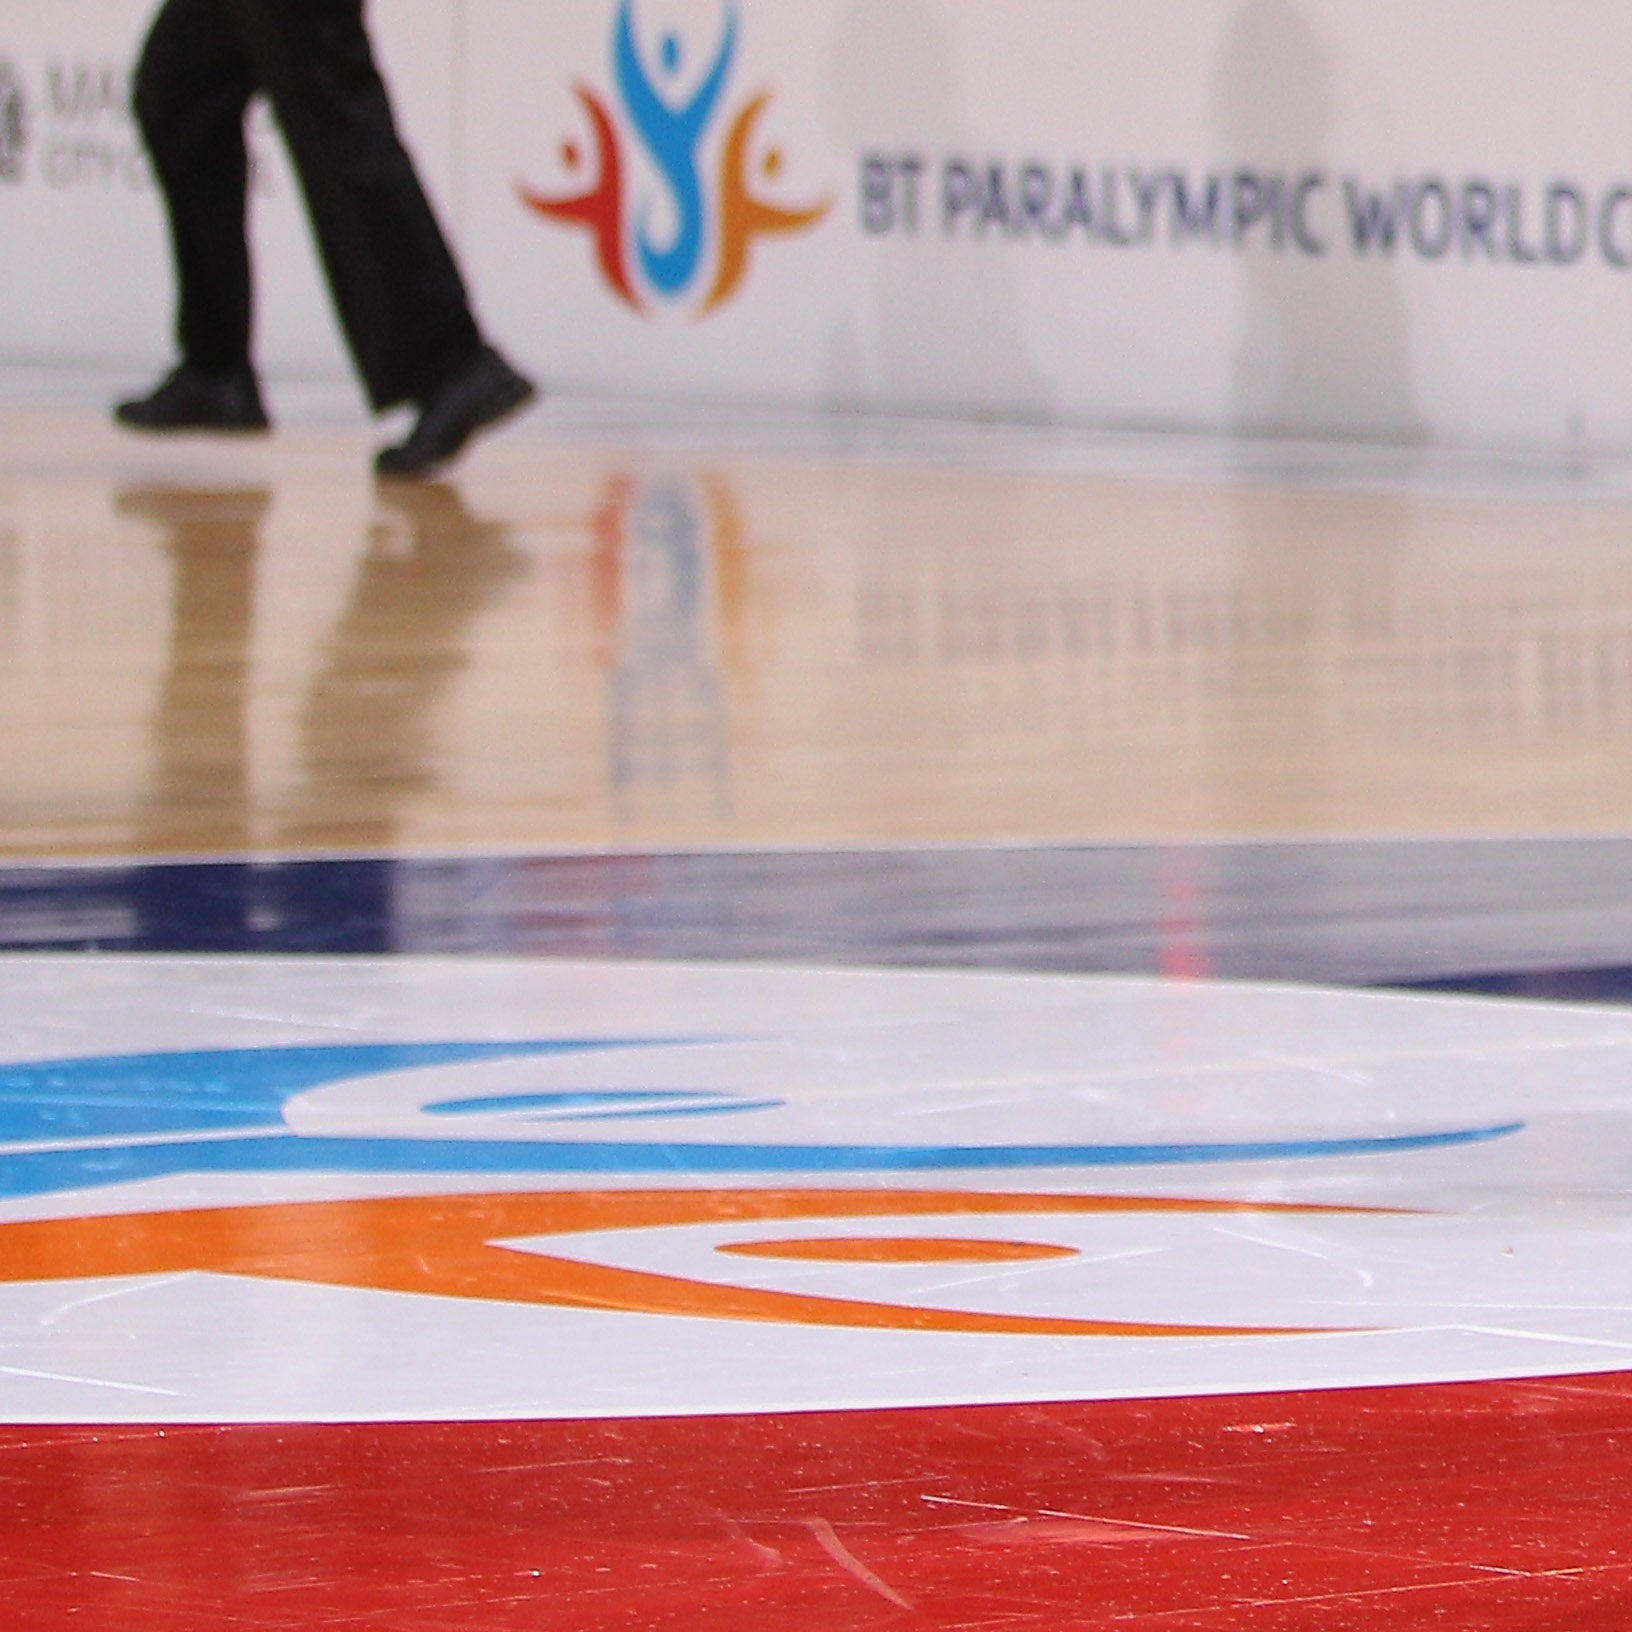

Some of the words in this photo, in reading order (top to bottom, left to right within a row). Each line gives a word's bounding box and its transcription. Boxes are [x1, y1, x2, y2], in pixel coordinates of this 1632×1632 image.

[859, 154, 925, 235] BT
[941, 159, 1327, 257] PARALYMPIC
[1342, 175, 1587, 266] WORLD
